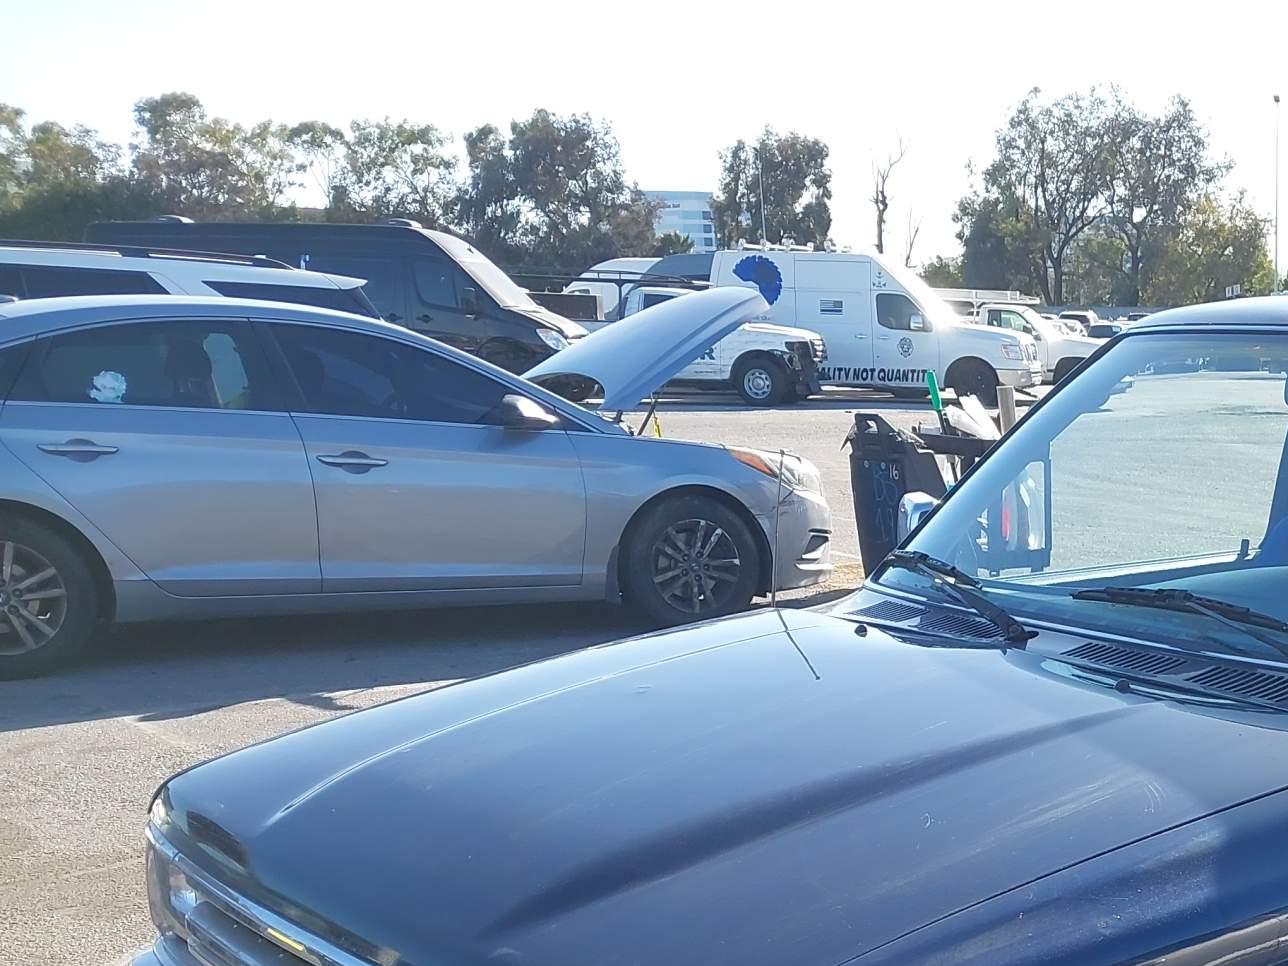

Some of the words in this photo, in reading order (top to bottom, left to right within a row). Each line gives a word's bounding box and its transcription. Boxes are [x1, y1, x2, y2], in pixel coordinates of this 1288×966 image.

[816, 367, 851, 380] ALITY
[853, 367, 876, 381] NOT
[877, 368, 936, 383] QUANTIT
[889, 463, 899, 480] 16
